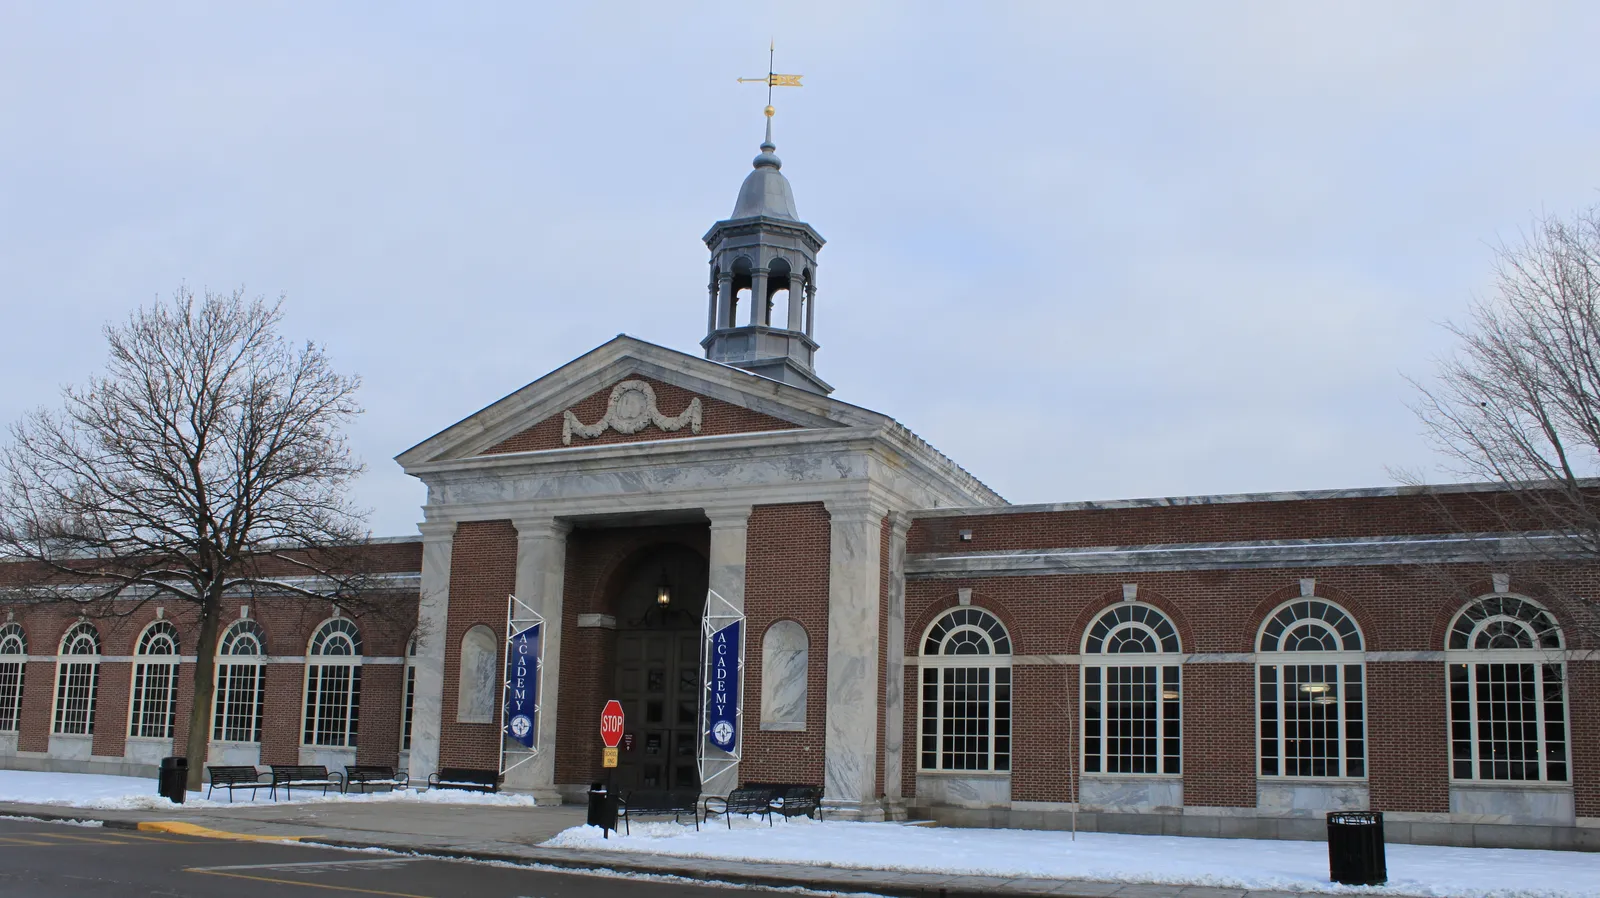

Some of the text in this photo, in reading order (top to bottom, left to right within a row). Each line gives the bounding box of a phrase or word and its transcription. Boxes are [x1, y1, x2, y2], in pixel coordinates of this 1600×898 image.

[514, 634, 528, 711] ACADEMY
[716, 632, 728, 716] ACADEMY
[603, 715, 623, 732] STOP
